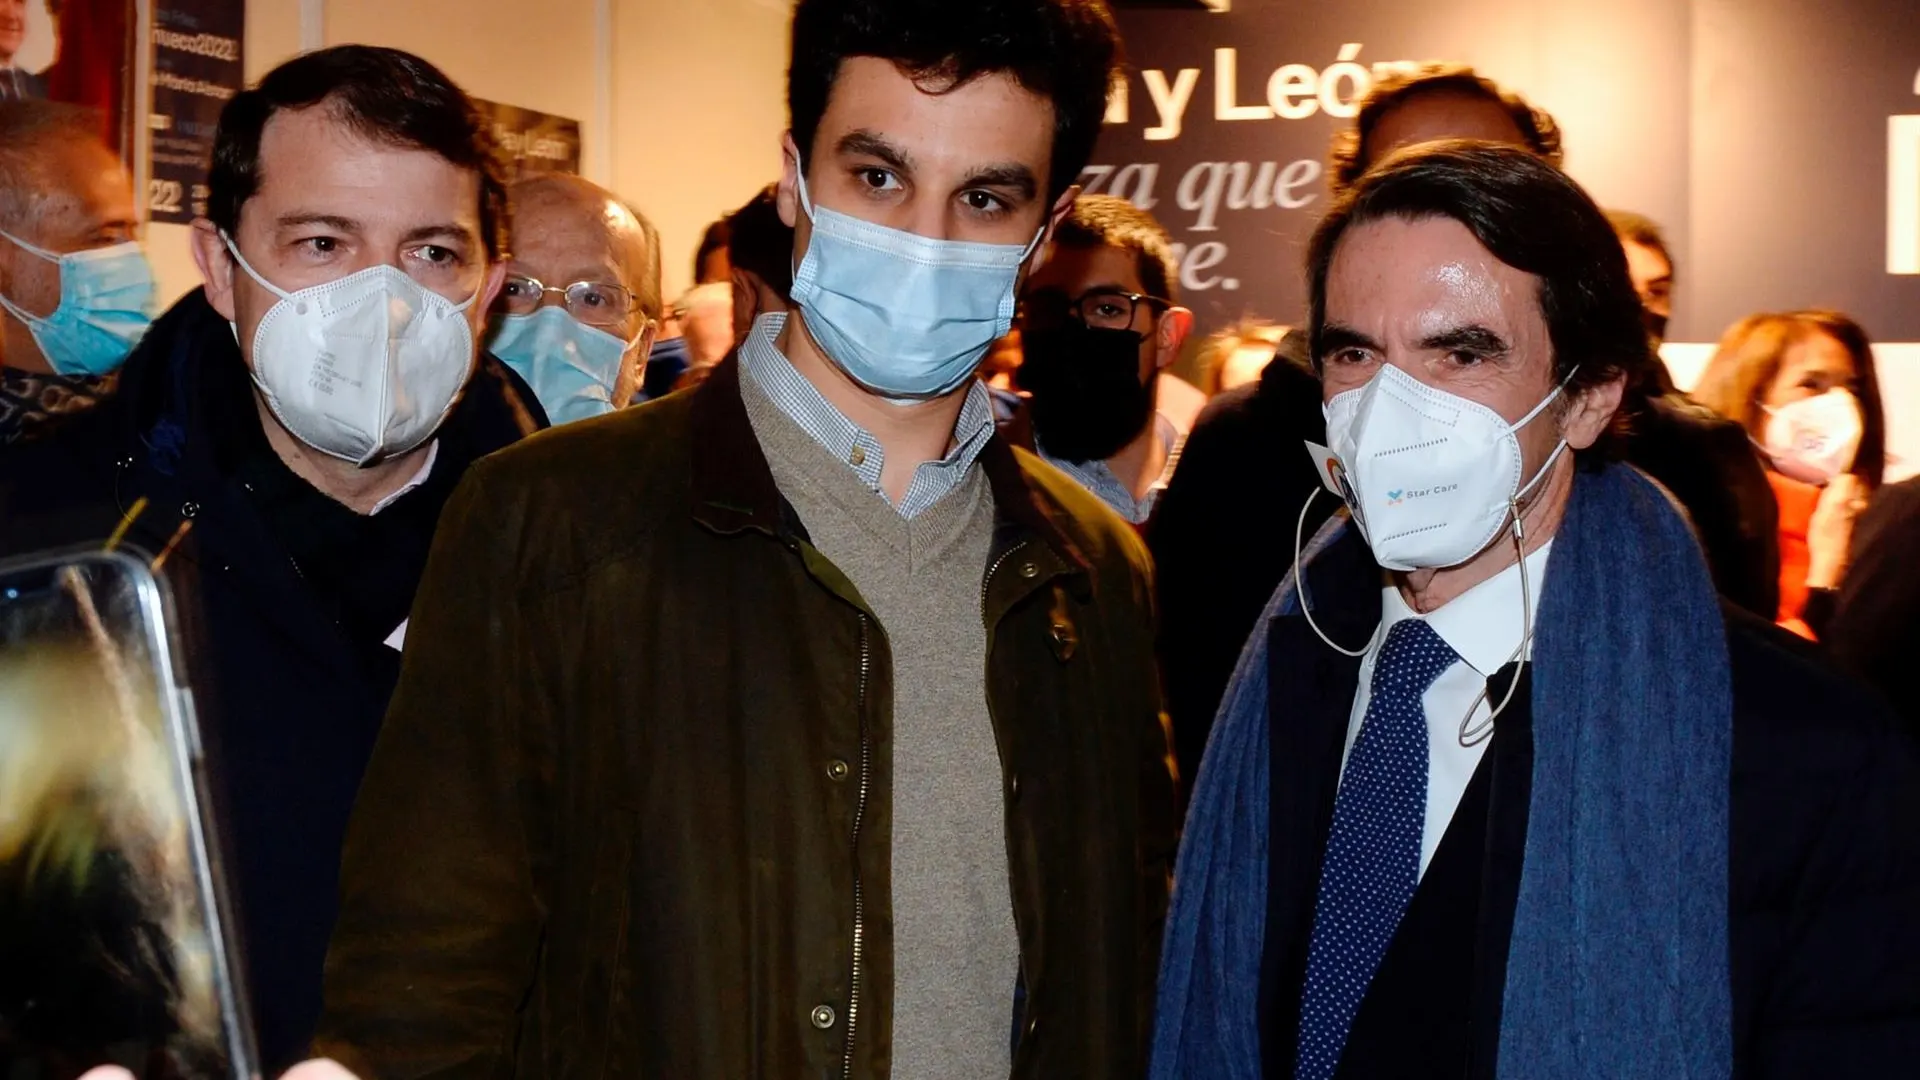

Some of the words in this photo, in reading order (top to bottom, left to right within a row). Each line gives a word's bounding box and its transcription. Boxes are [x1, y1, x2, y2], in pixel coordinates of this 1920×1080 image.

[1142, 69, 1201, 140] y
[1215, 43, 1414, 120] Leó
[1176, 159, 1321, 231] que
[1406, 489, 1430, 499] Star
[1433, 483, 1458, 495] Care
